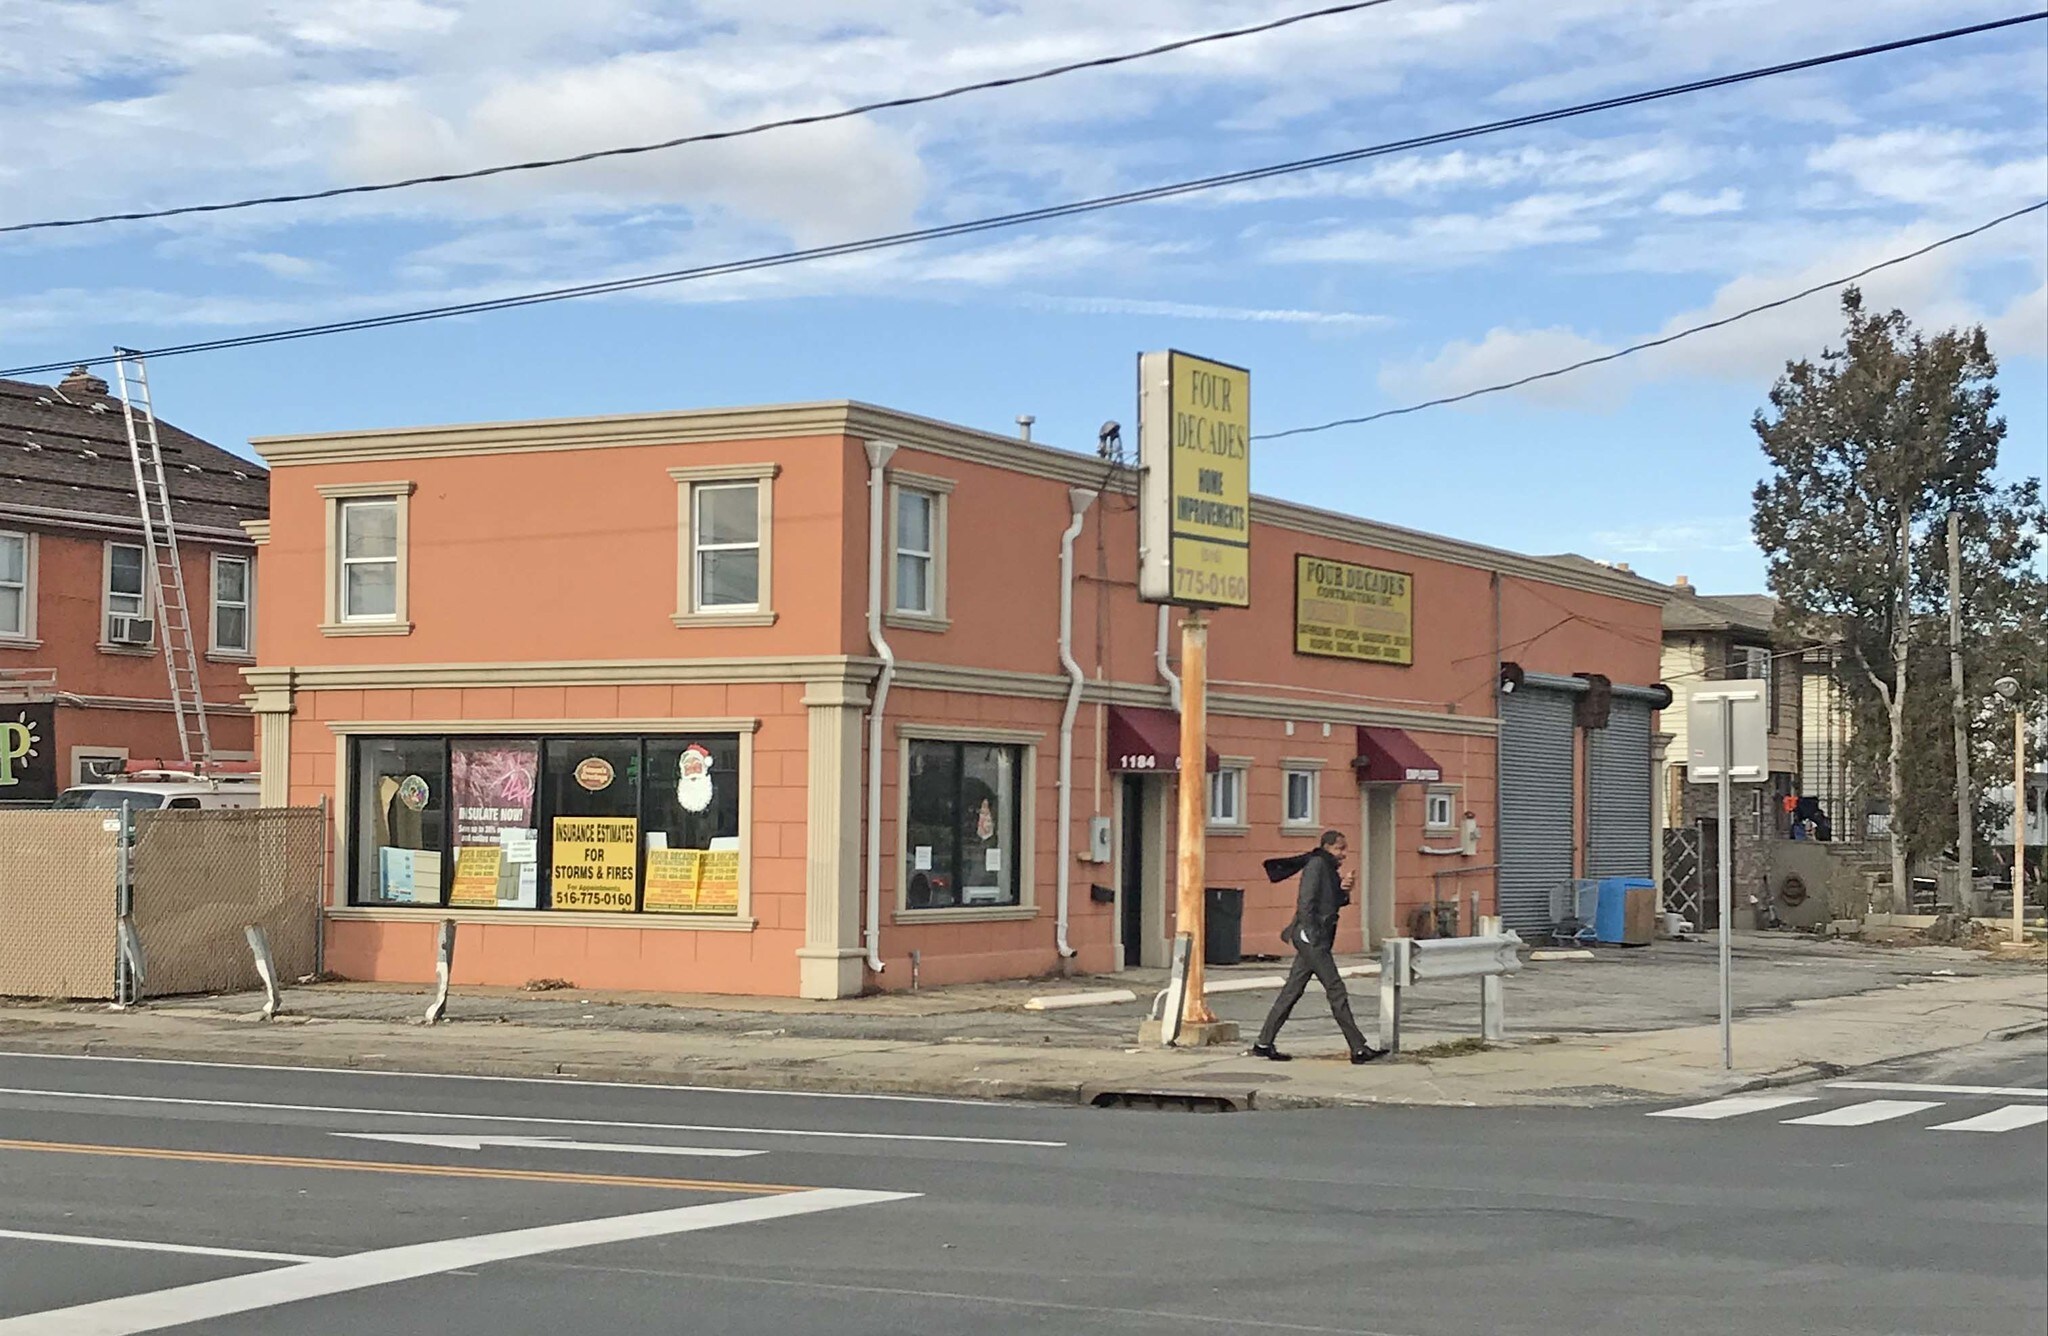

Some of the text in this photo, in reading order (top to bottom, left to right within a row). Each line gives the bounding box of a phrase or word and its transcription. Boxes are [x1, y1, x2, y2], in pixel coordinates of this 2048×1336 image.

[1191, 370, 1232, 413] FOUR
[1177, 412, 1246, 460] DECADES
[1198, 467, 1223, 496] HOME
[1177, 495, 1244, 531] IMPROVEMENTS
[1176, 566, 1246, 600] 775-0160
[1307, 561, 1406, 597] FOUR DECADES
[1120, 755, 1156, 769] 1184
[459, 807, 524, 822] INSULATE NOW!
[555, 823, 634, 844] INSURANCE ESTIMATES
[584, 848, 605, 862] FOR
[555, 866, 634, 880] STORMS & FIRES
[556, 891, 632, 906] 516-775-0160
